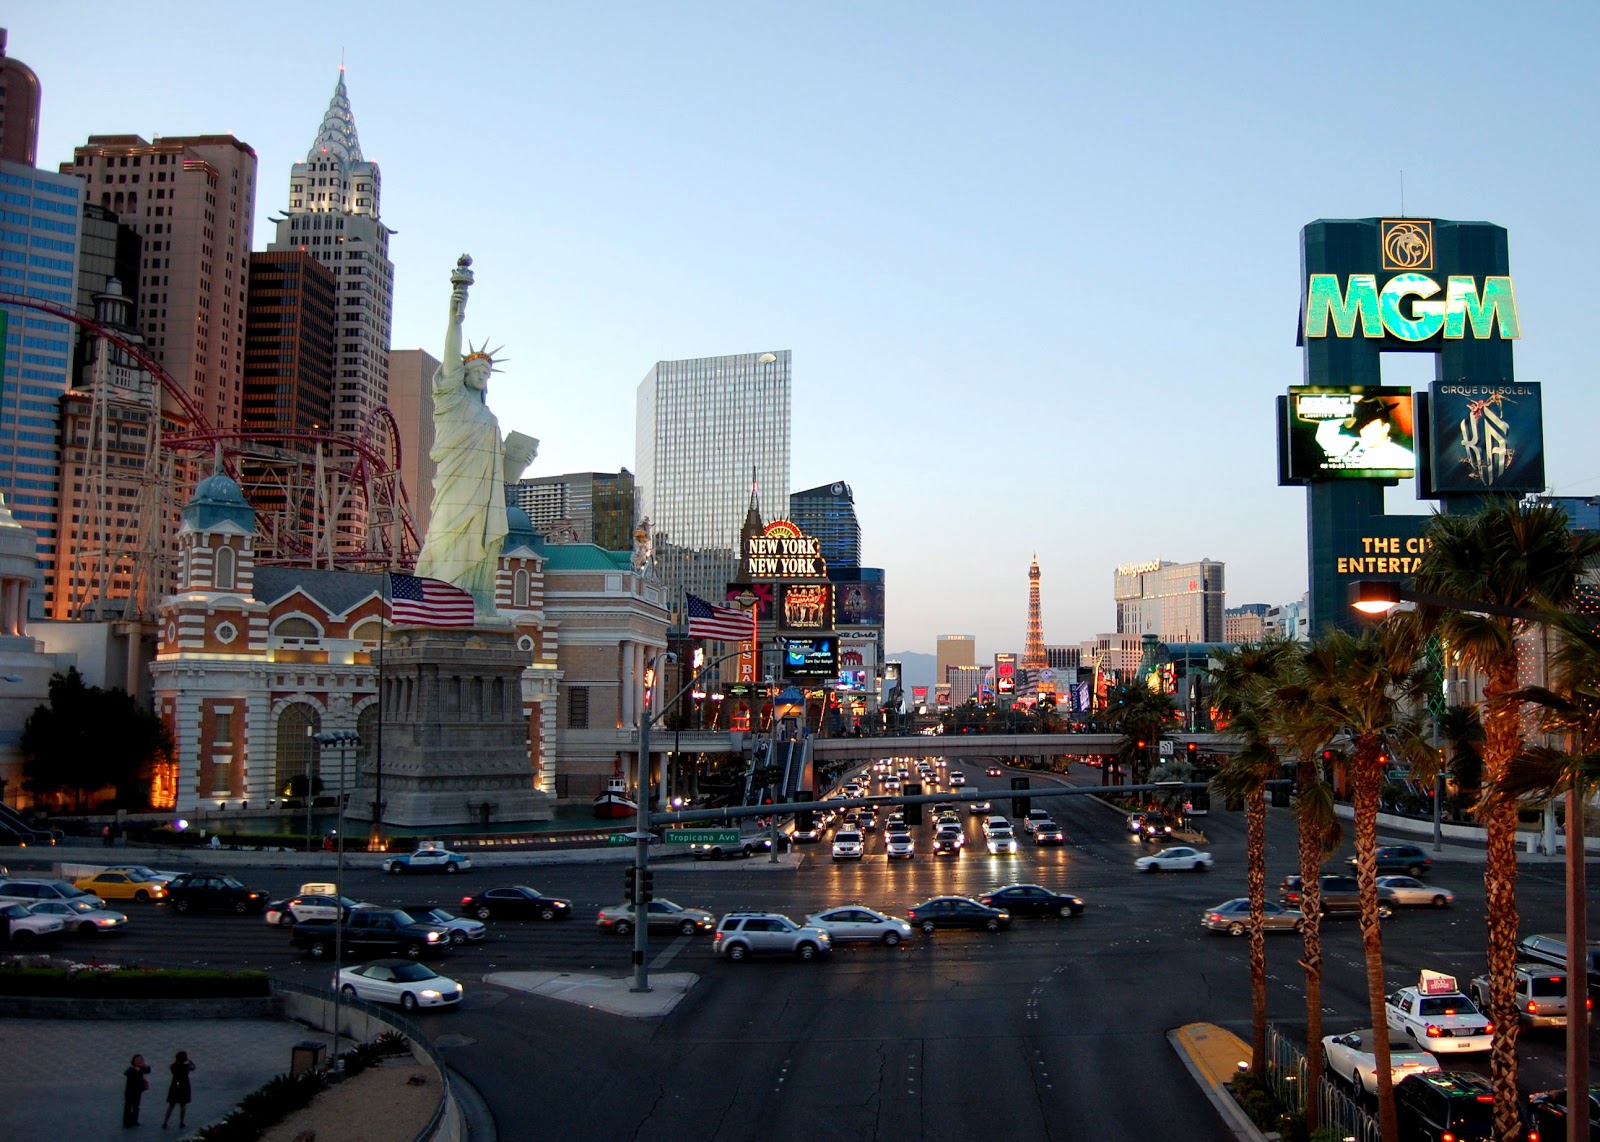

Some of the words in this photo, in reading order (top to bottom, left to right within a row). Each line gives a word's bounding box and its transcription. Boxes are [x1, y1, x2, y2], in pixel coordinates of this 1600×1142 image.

[1306, 273, 1521, 342] MGM
[1441, 385, 1478, 396] CIRQUE
[1481, 386, 1495, 394] DU
[1498, 386, 1532, 395] SOLEIL
[749, 539, 778, 555] NEW
[781, 539, 817, 555] YORK
[1361, 537, 1400, 554] THE
[748, 558, 778, 574] NEW
[781, 558, 816, 574] YORK
[1118, 559, 1160, 577] hollywood
[1337, 557, 1422, 574] ENTERTA
[852, 631, 876, 639] Carlo
[669, 833, 714, 842] Tropicana
[719, 833, 736, 841] Ave
